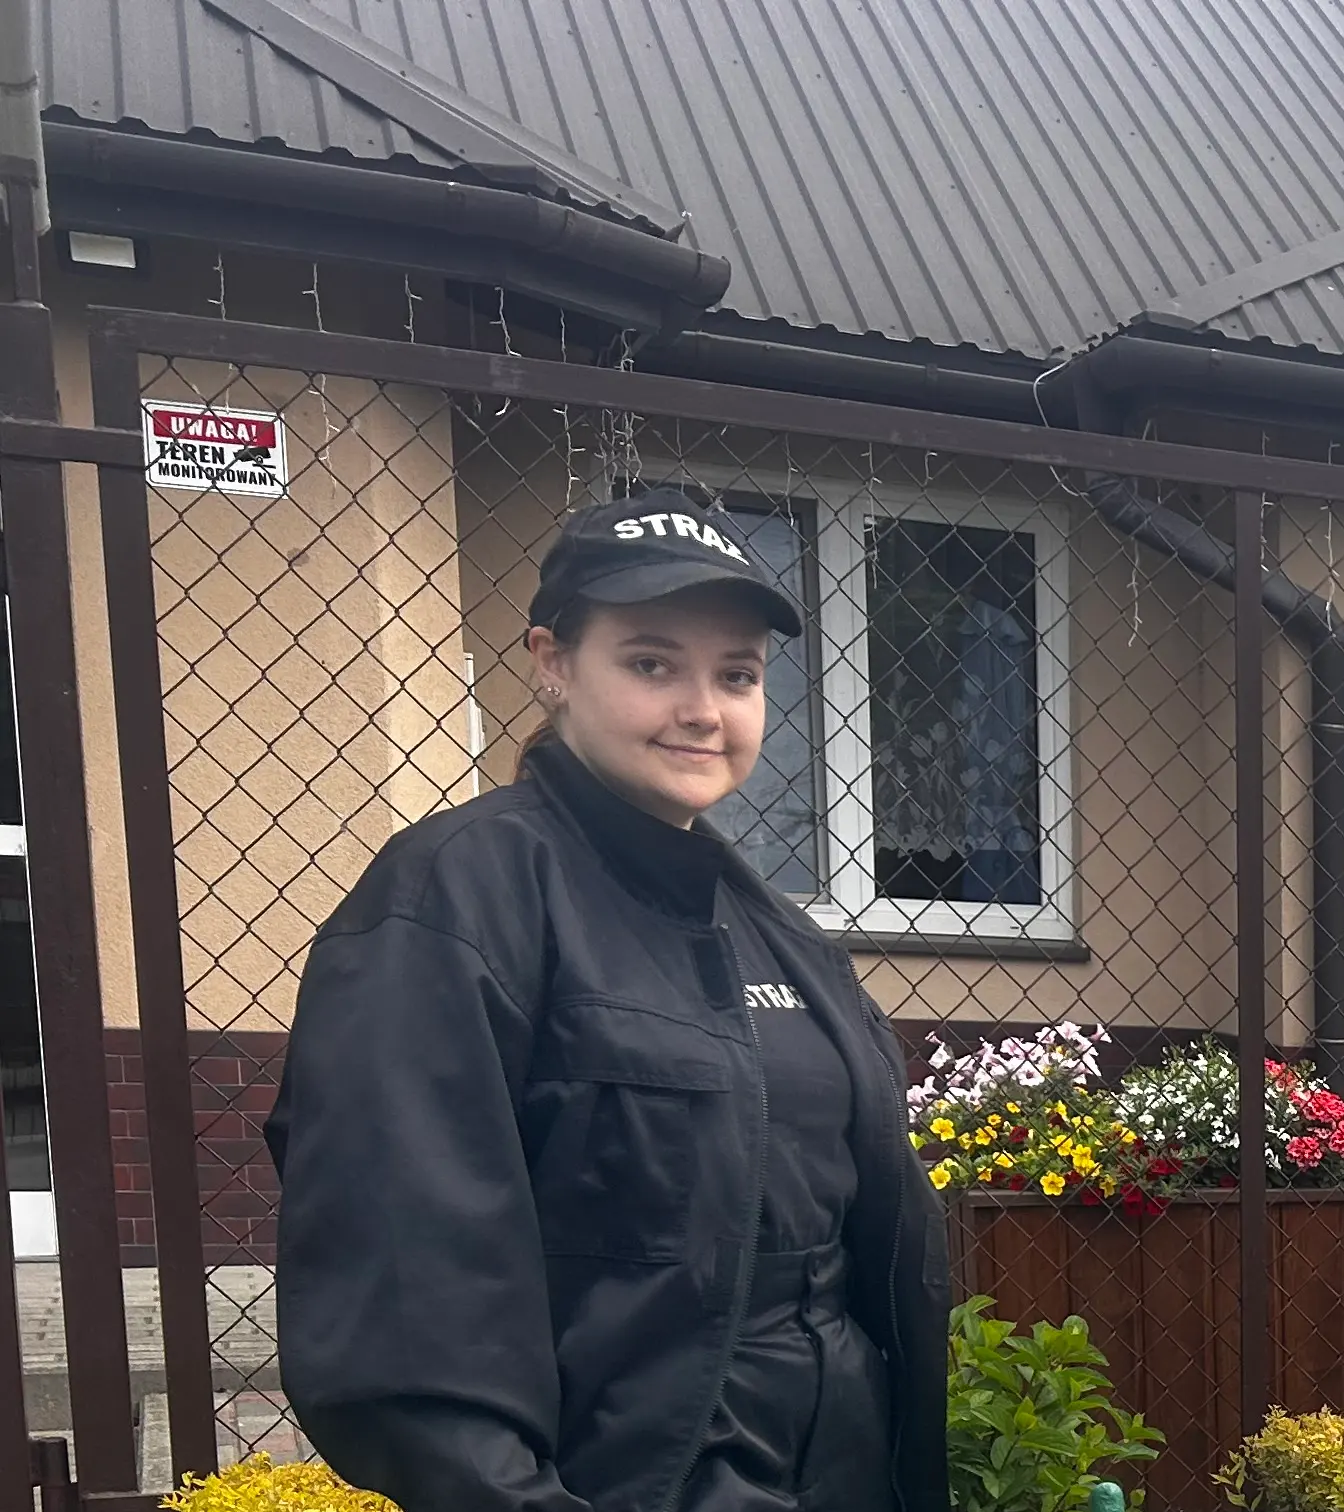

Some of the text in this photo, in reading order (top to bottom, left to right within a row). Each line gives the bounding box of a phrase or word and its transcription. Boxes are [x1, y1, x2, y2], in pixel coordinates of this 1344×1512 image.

[170, 416, 258, 443] UWAGA!
[156, 440, 225, 465] TEREN
[158, 462, 277, 487] MONITOROWANY
